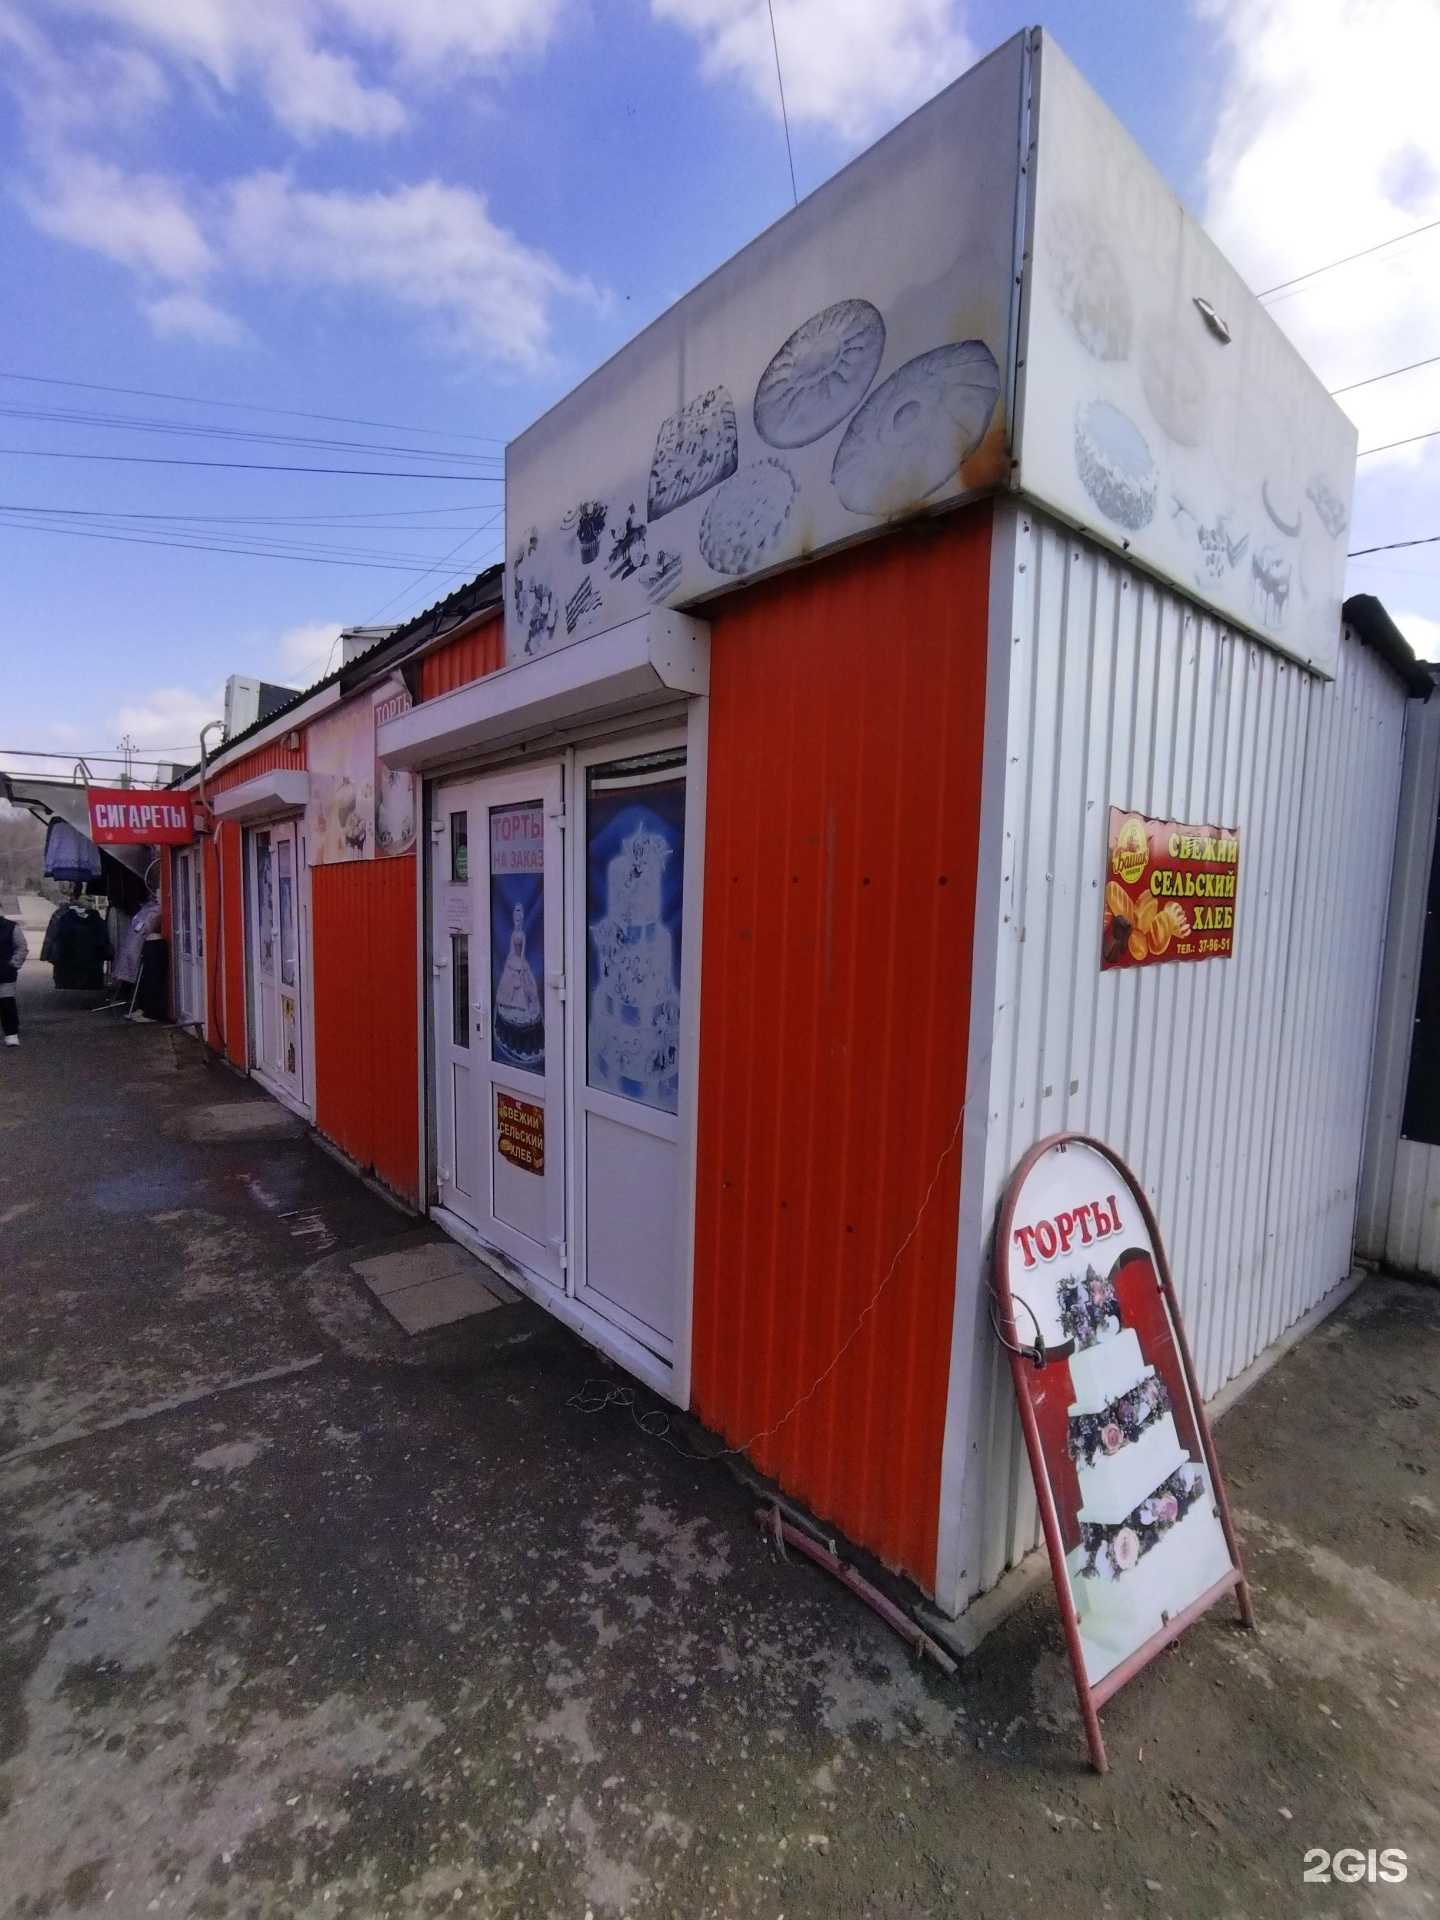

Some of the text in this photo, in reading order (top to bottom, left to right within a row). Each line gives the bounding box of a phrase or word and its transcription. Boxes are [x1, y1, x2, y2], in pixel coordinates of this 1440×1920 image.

[95, 803, 187, 829] СИГАРЕТЫ
[1168, 830, 1238, 864] СВЕЖИЙ
[1150, 869, 1236, 898] СЕЛЬСКИЙ
[1192, 905, 1233, 930] ХЛЕБ
[500, 1122, 544, 1151] СЕЛЬСКИЙ
[1013, 1194, 1124, 1269] ТОРТЫ
